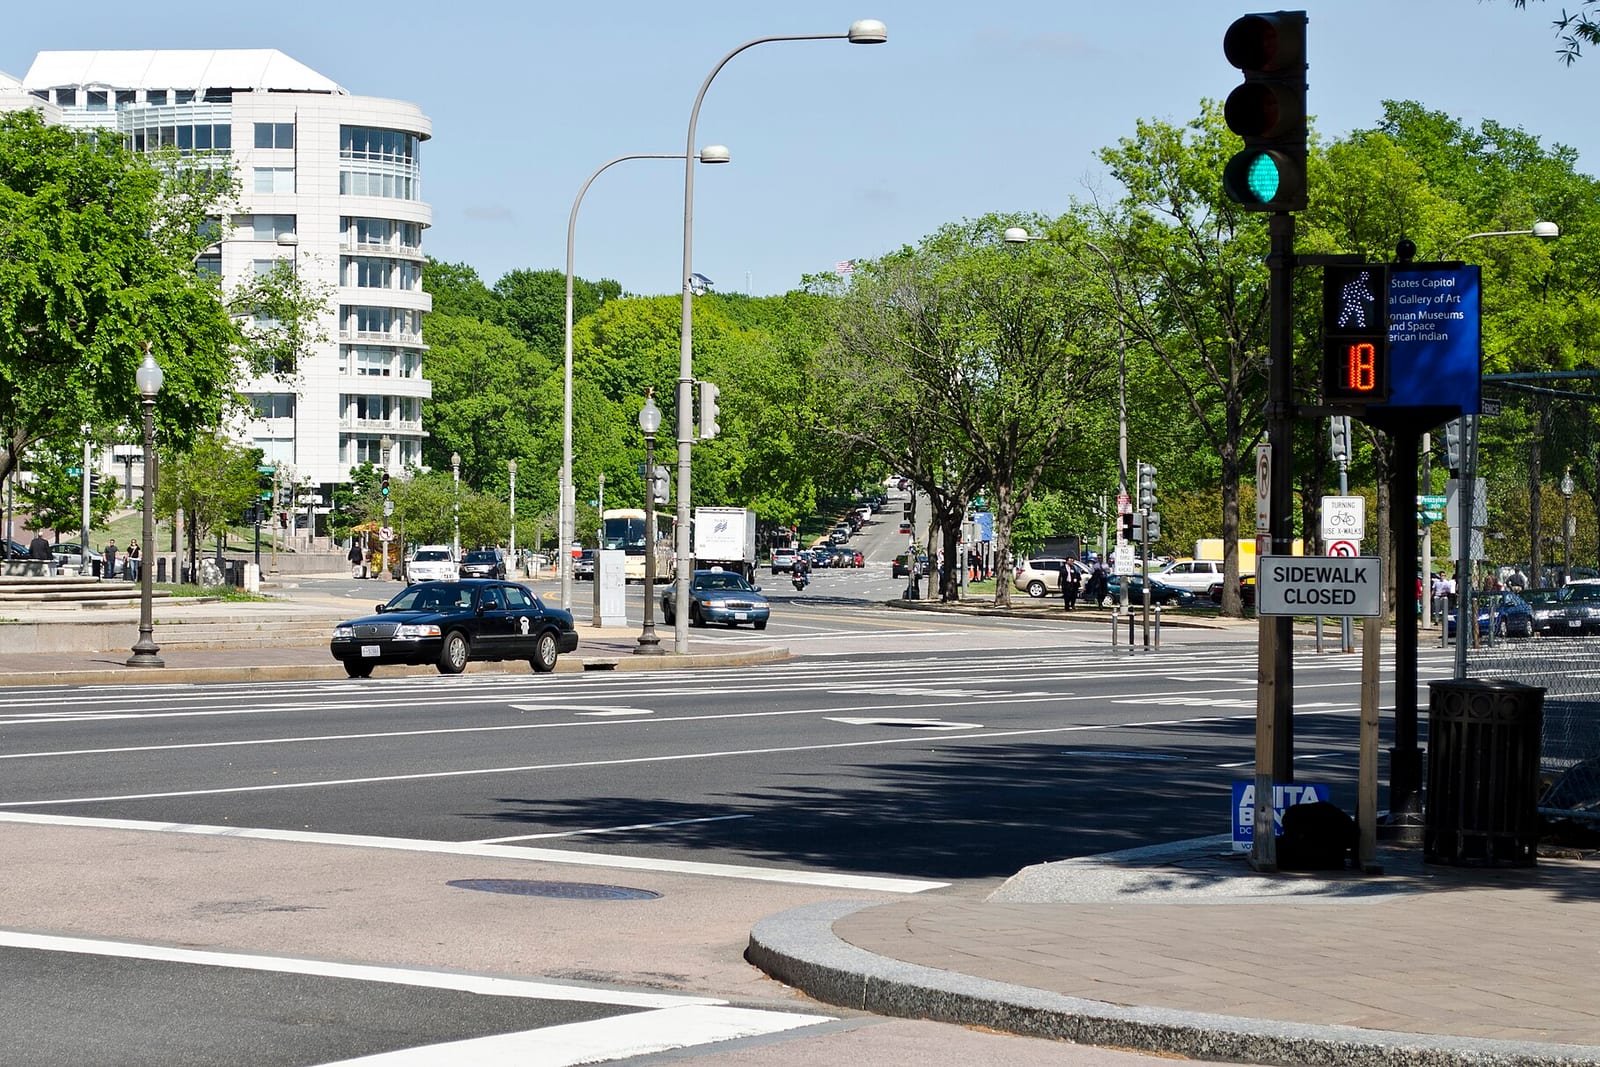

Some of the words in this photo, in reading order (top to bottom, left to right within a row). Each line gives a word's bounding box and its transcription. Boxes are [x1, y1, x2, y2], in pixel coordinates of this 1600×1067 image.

[1391, 279, 1420, 288] States
[1422, 277, 1456, 288] Capitol
[1389, 296, 1397, 304] al
[1399, 294, 1432, 306] Gallery
[1434, 294, 1445, 303] of
[1446, 294, 1461, 303] Art
[1389, 312, 1416, 321] onian
[1418, 311, 1465, 320] Museums
[1407, 321, 1436, 332] Space
[1389, 333, 1417, 342] erican
[1419, 332, 1448, 341] Indian
[1350, 343, 1375, 390] 18
[1331, 501, 1356, 509] TURNING
[1323, 527, 1335, 535] USE
[1337, 527, 1362, 535] X-WALKS
[1273, 566, 1368, 584] SIDEWALK
[1284, 588, 1356, 605] CLOSED
[1239, 784, 1319, 809] AITA
[1239, 826, 1252, 835] DC
[1241, 842, 1254, 850] VOT
